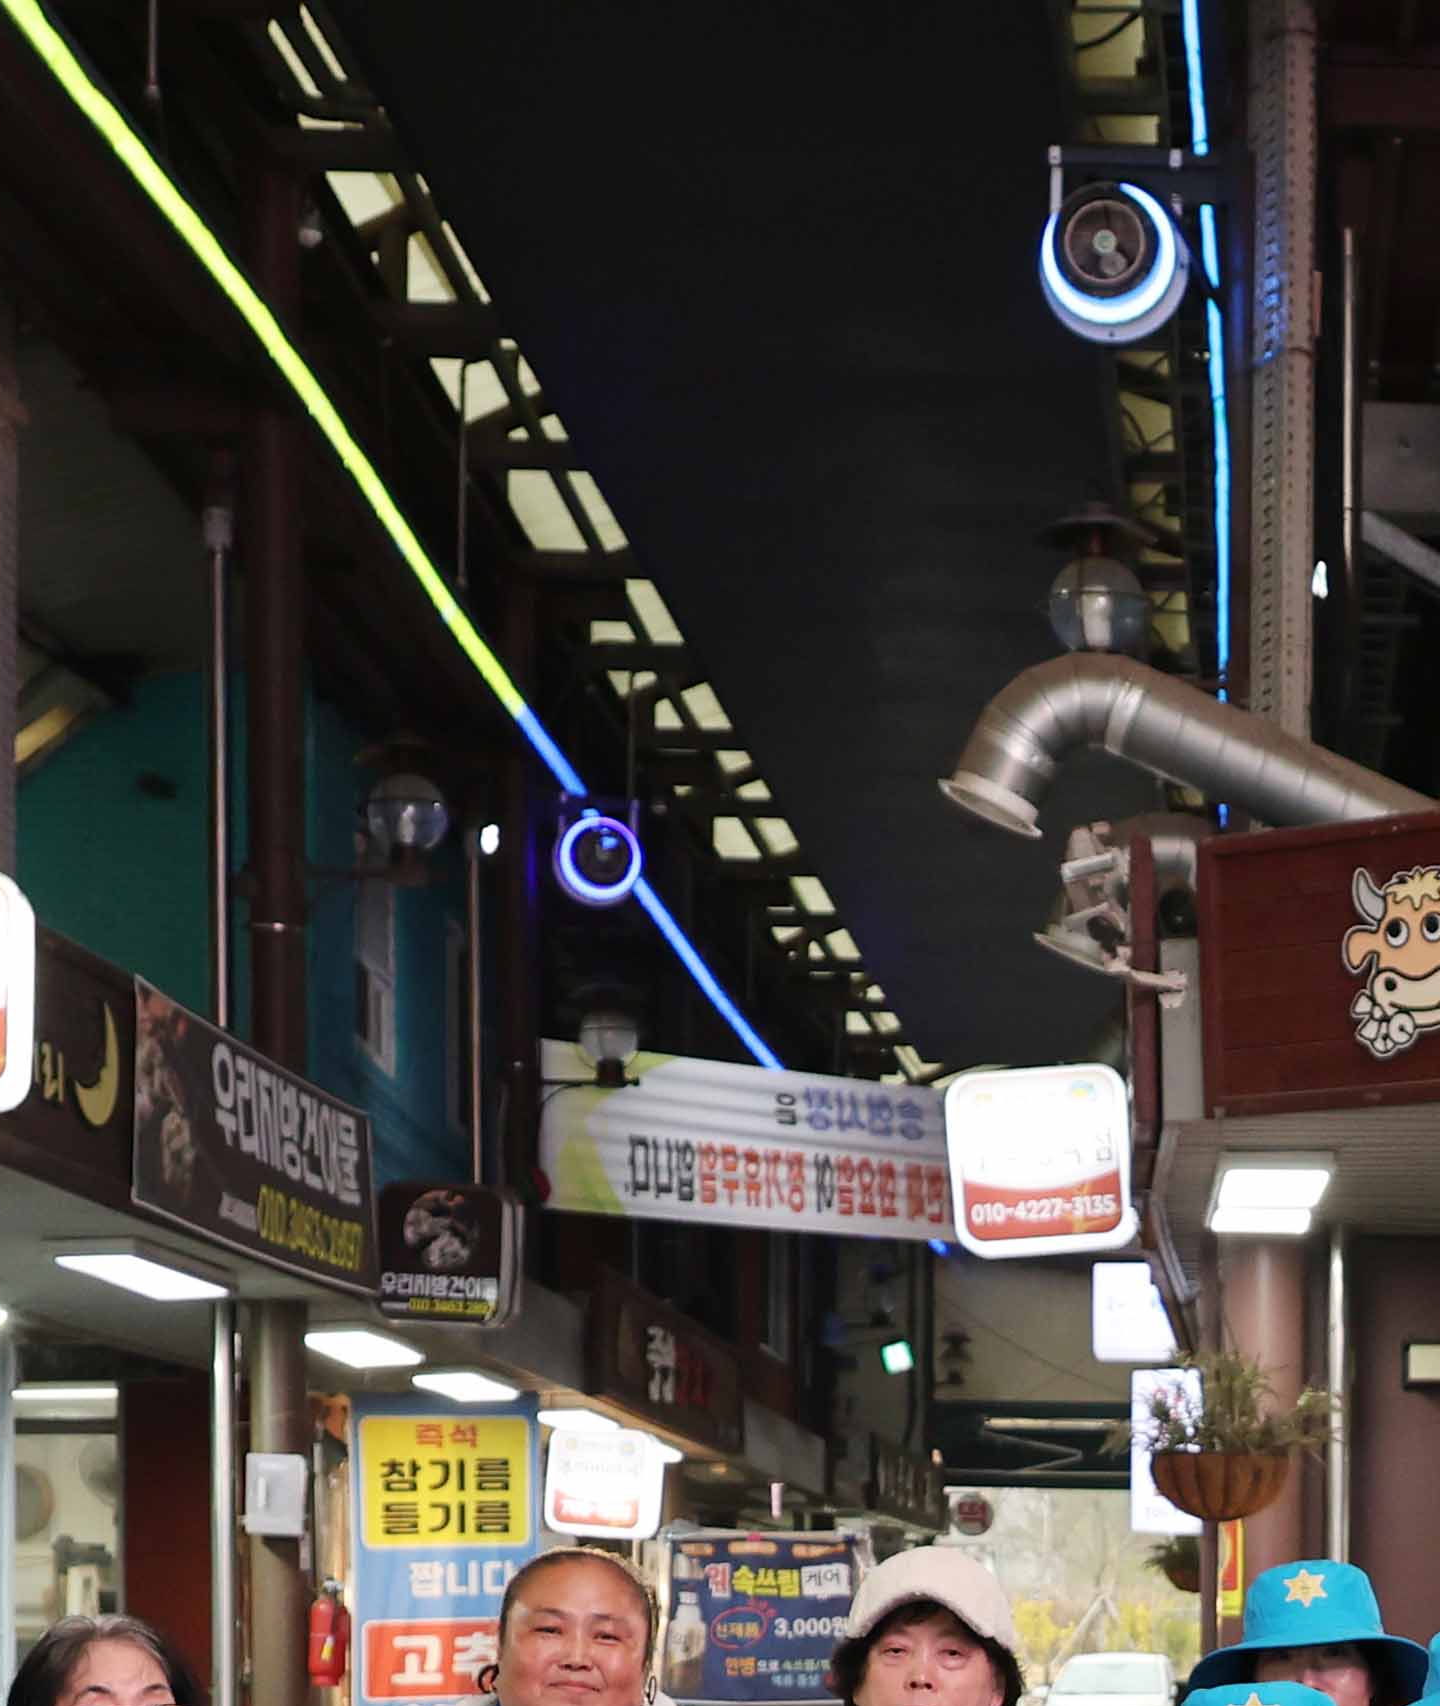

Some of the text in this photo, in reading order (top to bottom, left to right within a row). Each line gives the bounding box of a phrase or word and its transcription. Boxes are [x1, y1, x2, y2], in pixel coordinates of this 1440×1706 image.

[971, 1195, 1116, 1226] 010-4227-3135
[380, 1458, 511, 1492] 참기름
[380, 1501, 511, 1535] 들기름
[733, 1565, 801, 1598] 속쓰림
